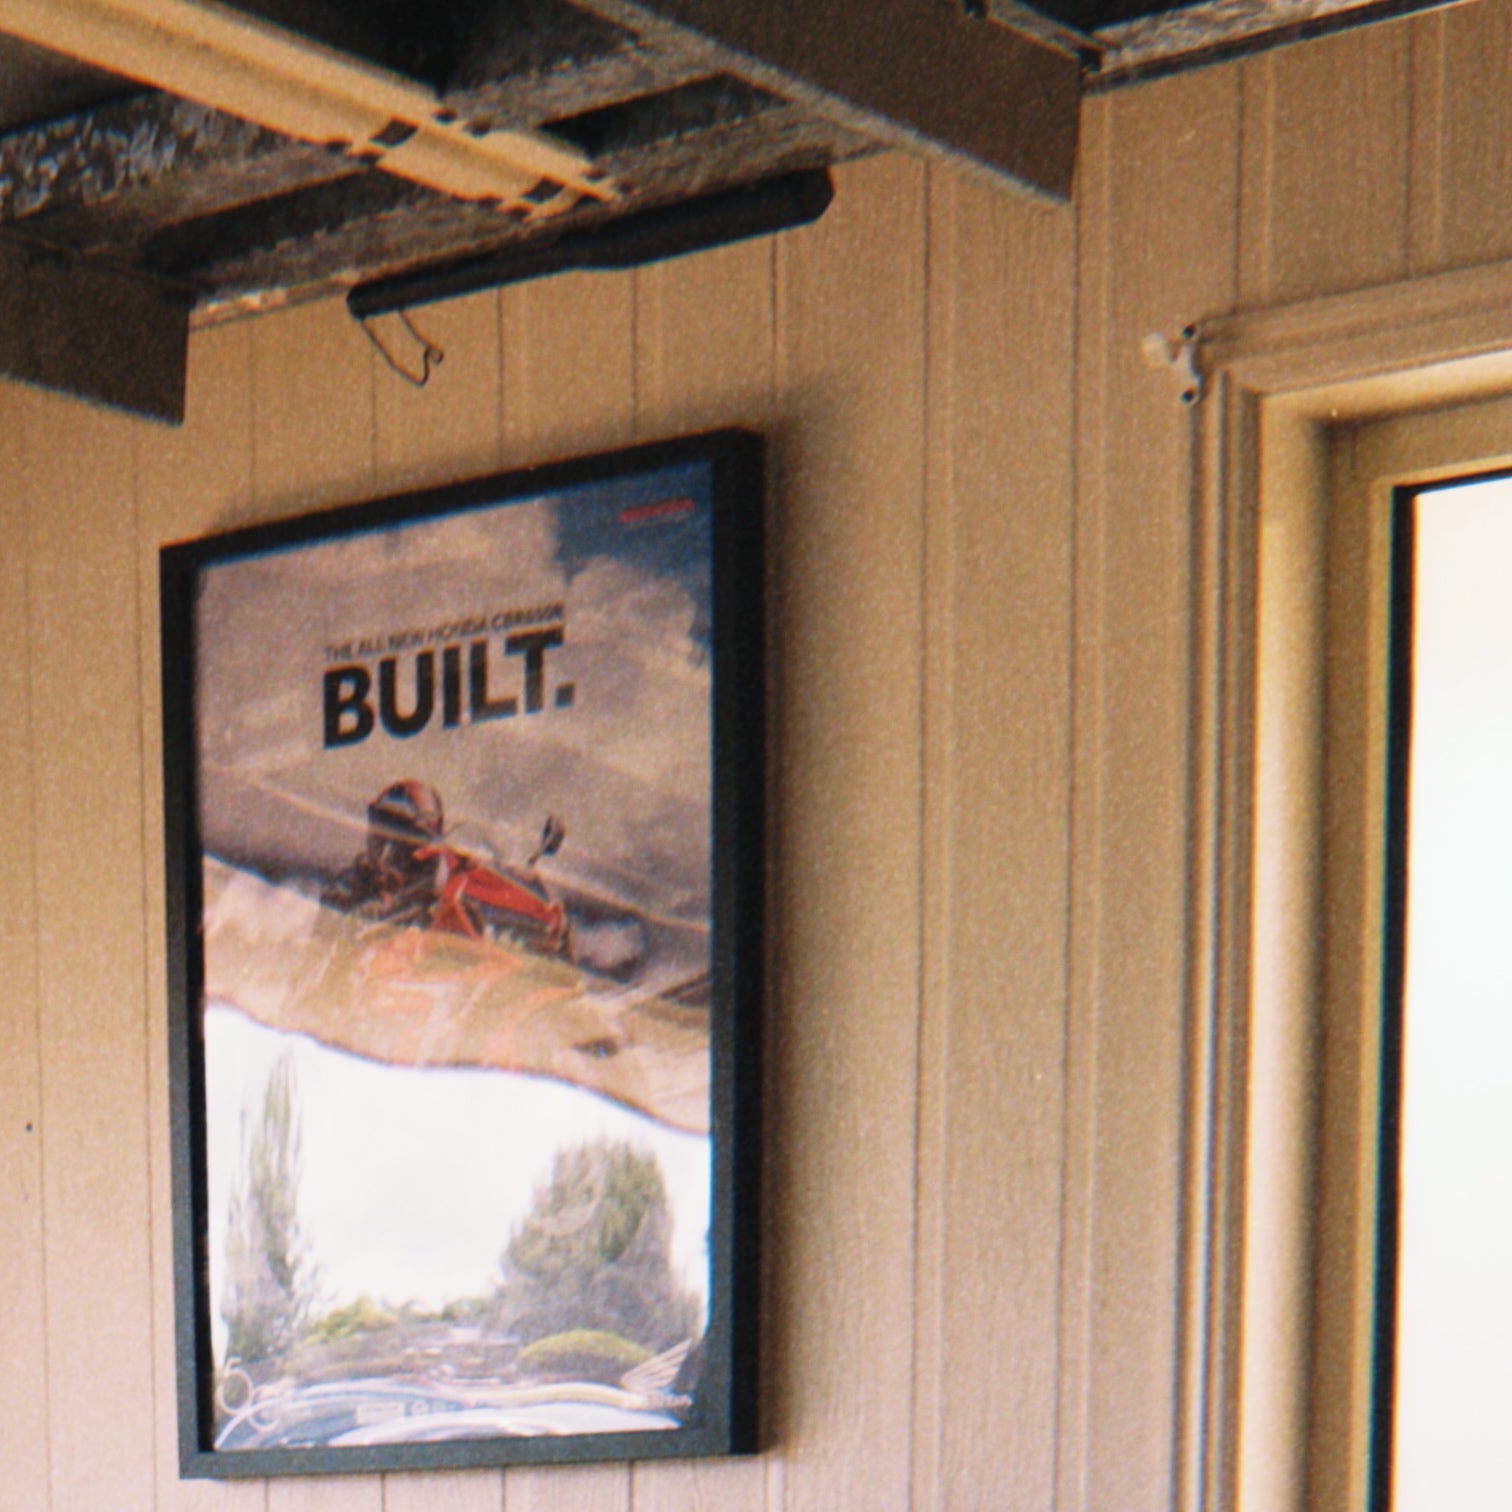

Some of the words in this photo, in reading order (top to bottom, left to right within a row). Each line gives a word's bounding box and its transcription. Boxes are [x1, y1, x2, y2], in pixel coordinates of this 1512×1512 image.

[324, 642, 352, 661] THE
[358, 637, 382, 656] ALL
[324, 622, 575, 750] BUILT.
